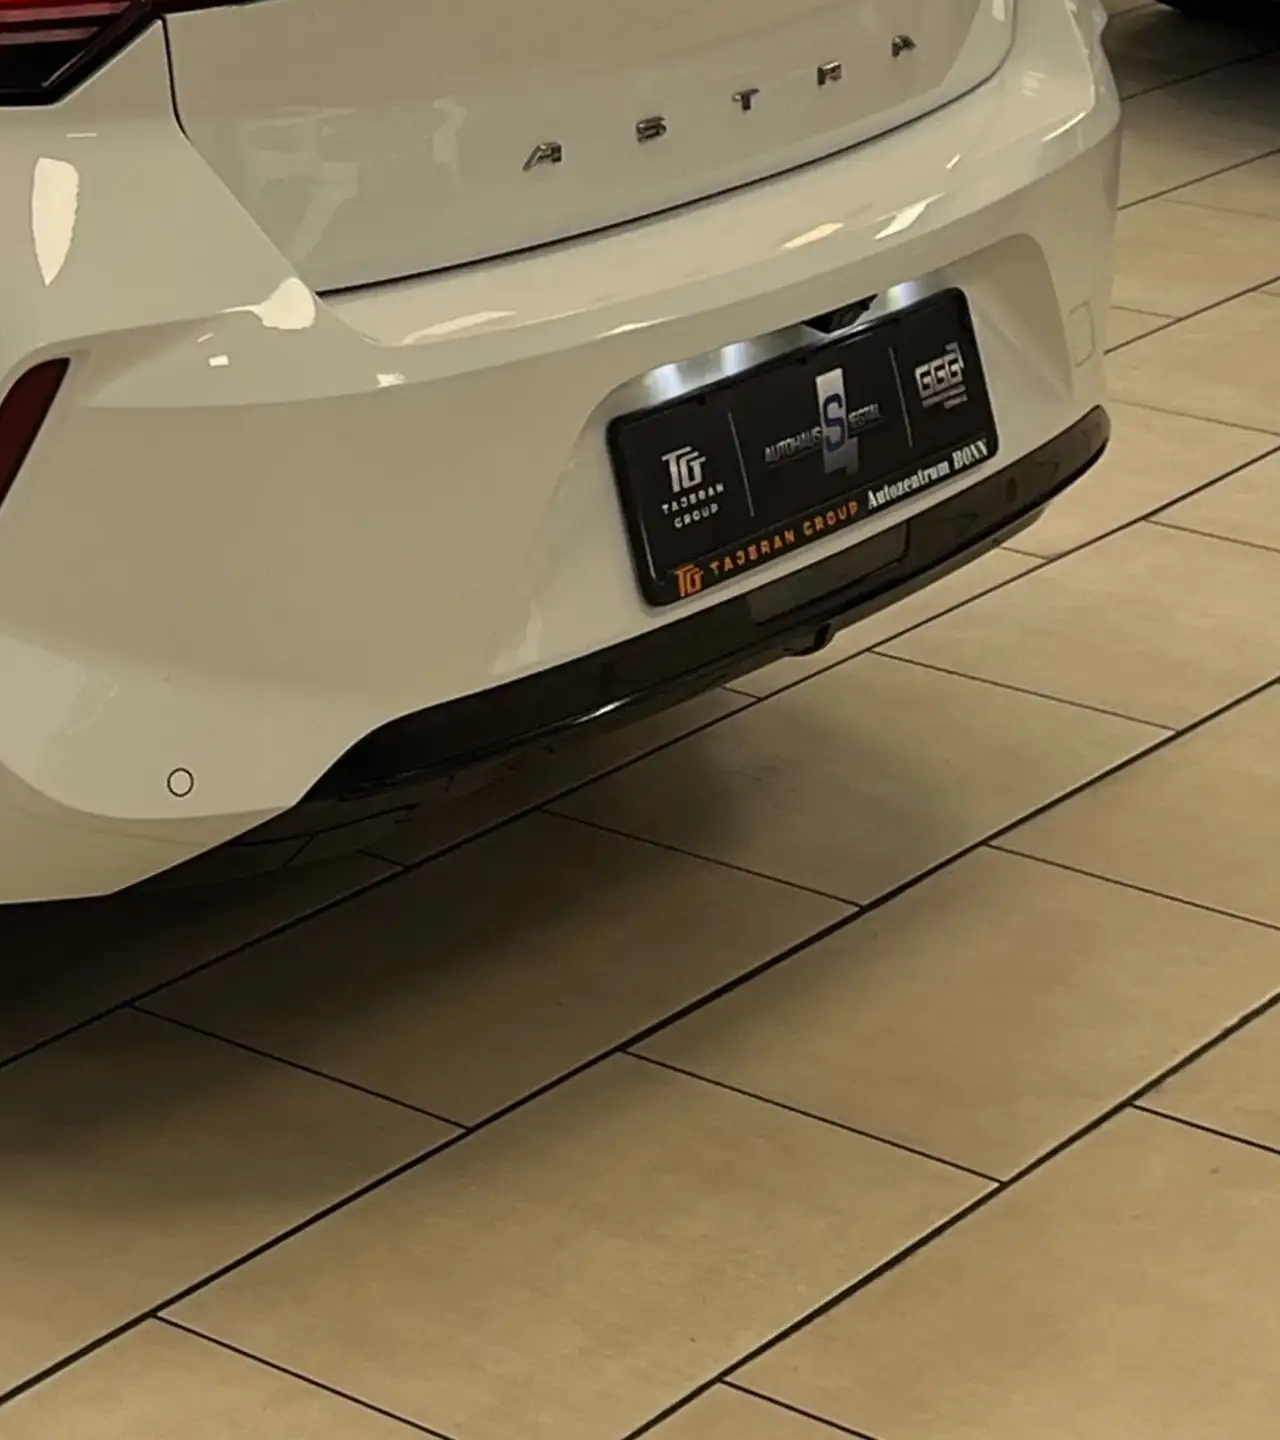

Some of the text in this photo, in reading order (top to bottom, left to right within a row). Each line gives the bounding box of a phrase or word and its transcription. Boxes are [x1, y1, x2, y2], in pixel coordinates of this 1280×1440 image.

[523, 33, 917, 172] ASTRA
[673, 502, 719, 529] GROUP
[802, 500, 859, 537] GROUP
[867, 460, 951, 510] Autozentrum
